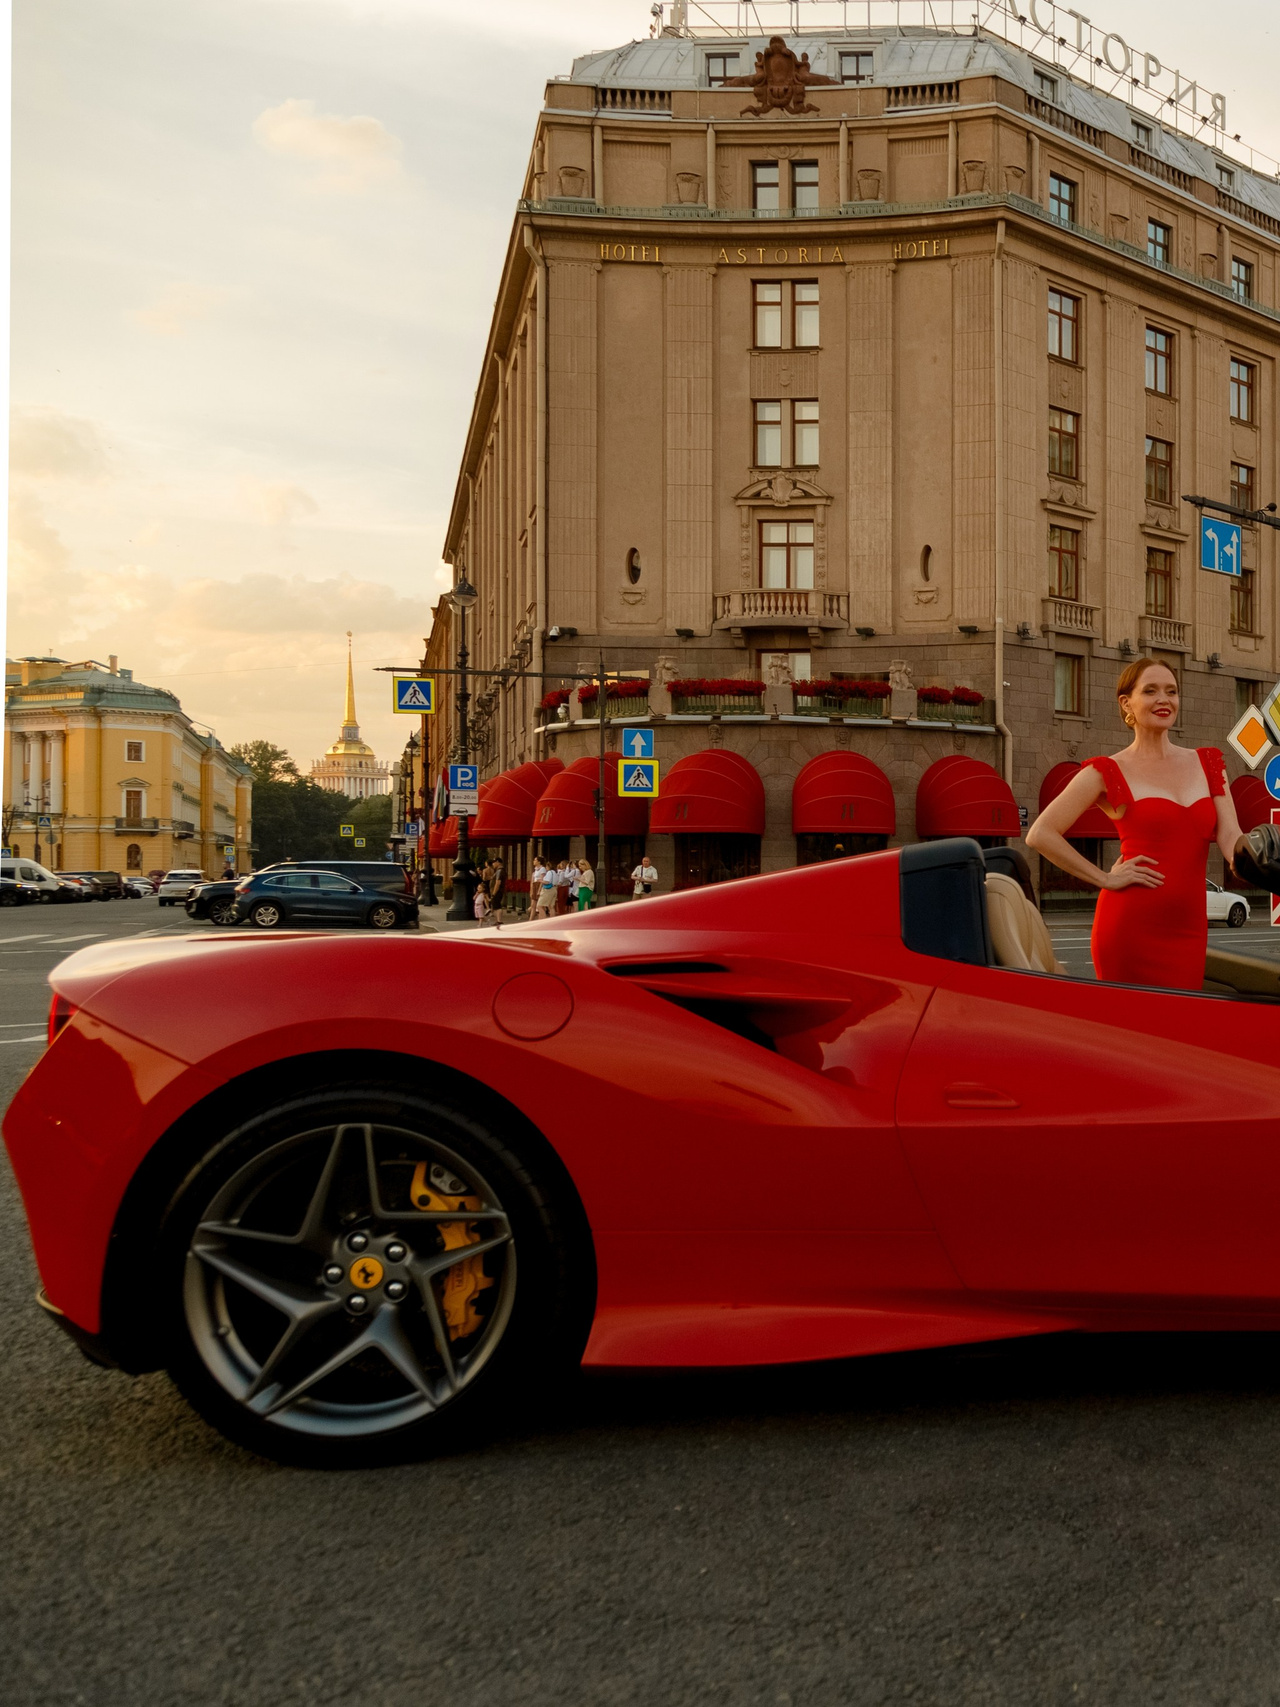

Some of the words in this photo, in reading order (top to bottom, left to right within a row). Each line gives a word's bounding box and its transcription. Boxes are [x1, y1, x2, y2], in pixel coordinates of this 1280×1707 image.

[600, 243, 661, 262] HOTEL
[718, 246, 844, 264] ASTORIA
[893, 239, 949, 259] HOTEL
[457, 768, 473, 787] P
